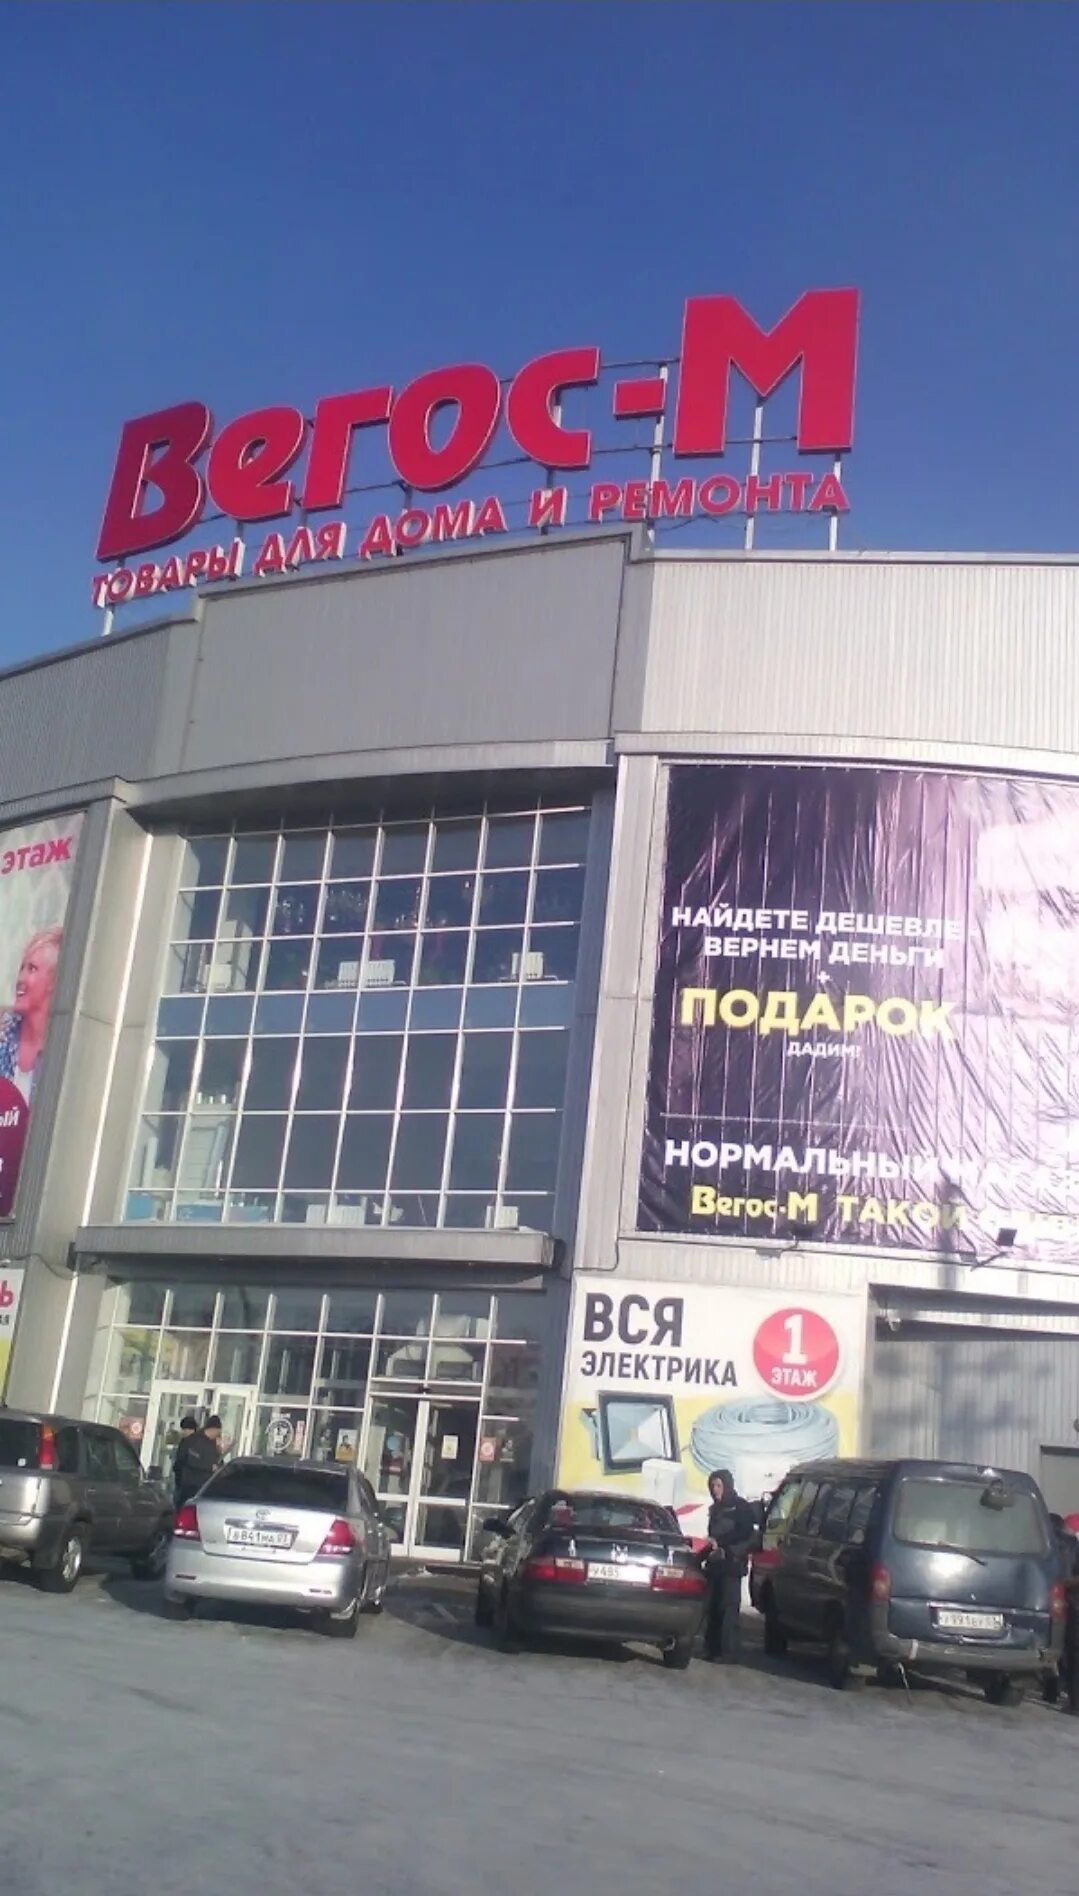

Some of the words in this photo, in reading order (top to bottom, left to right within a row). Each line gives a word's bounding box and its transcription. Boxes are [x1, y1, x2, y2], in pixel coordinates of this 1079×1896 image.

[96, 287, 860, 563] Вегос-М
[91, 537, 245, 608] ТОВАРЫ
[253, 522, 347, 577] ДЛЯ
[357, 499, 507, 560] ДОМА
[528, 486, 567, 528] И
[589, 472, 849, 522] РЕМОНТА
[1, 836, 72, 875] этаж
[672, 903, 808, 932] НАЙДЕТЕ
[815, 911, 961, 940] ДЕШЕВЛЕ
[704, 936, 821, 960] ВЕРНЕМ
[829, 941, 944, 968] ДЕНЬГИ
[681, 988, 956, 1040] ПОДАРОК
[787, 1041, 860, 1058] ДАДИМ!
[665, 1139, 938, 1181] НОРМАЛЬНЫЙ
[583, 1293, 684, 1347] ВСЯ
[782, 1314, 807, 1364] 1
[581, 1351, 738, 1387] ЭЛЕКТРИКА
[771, 1367, 817, 1387] ЭТАЖ
